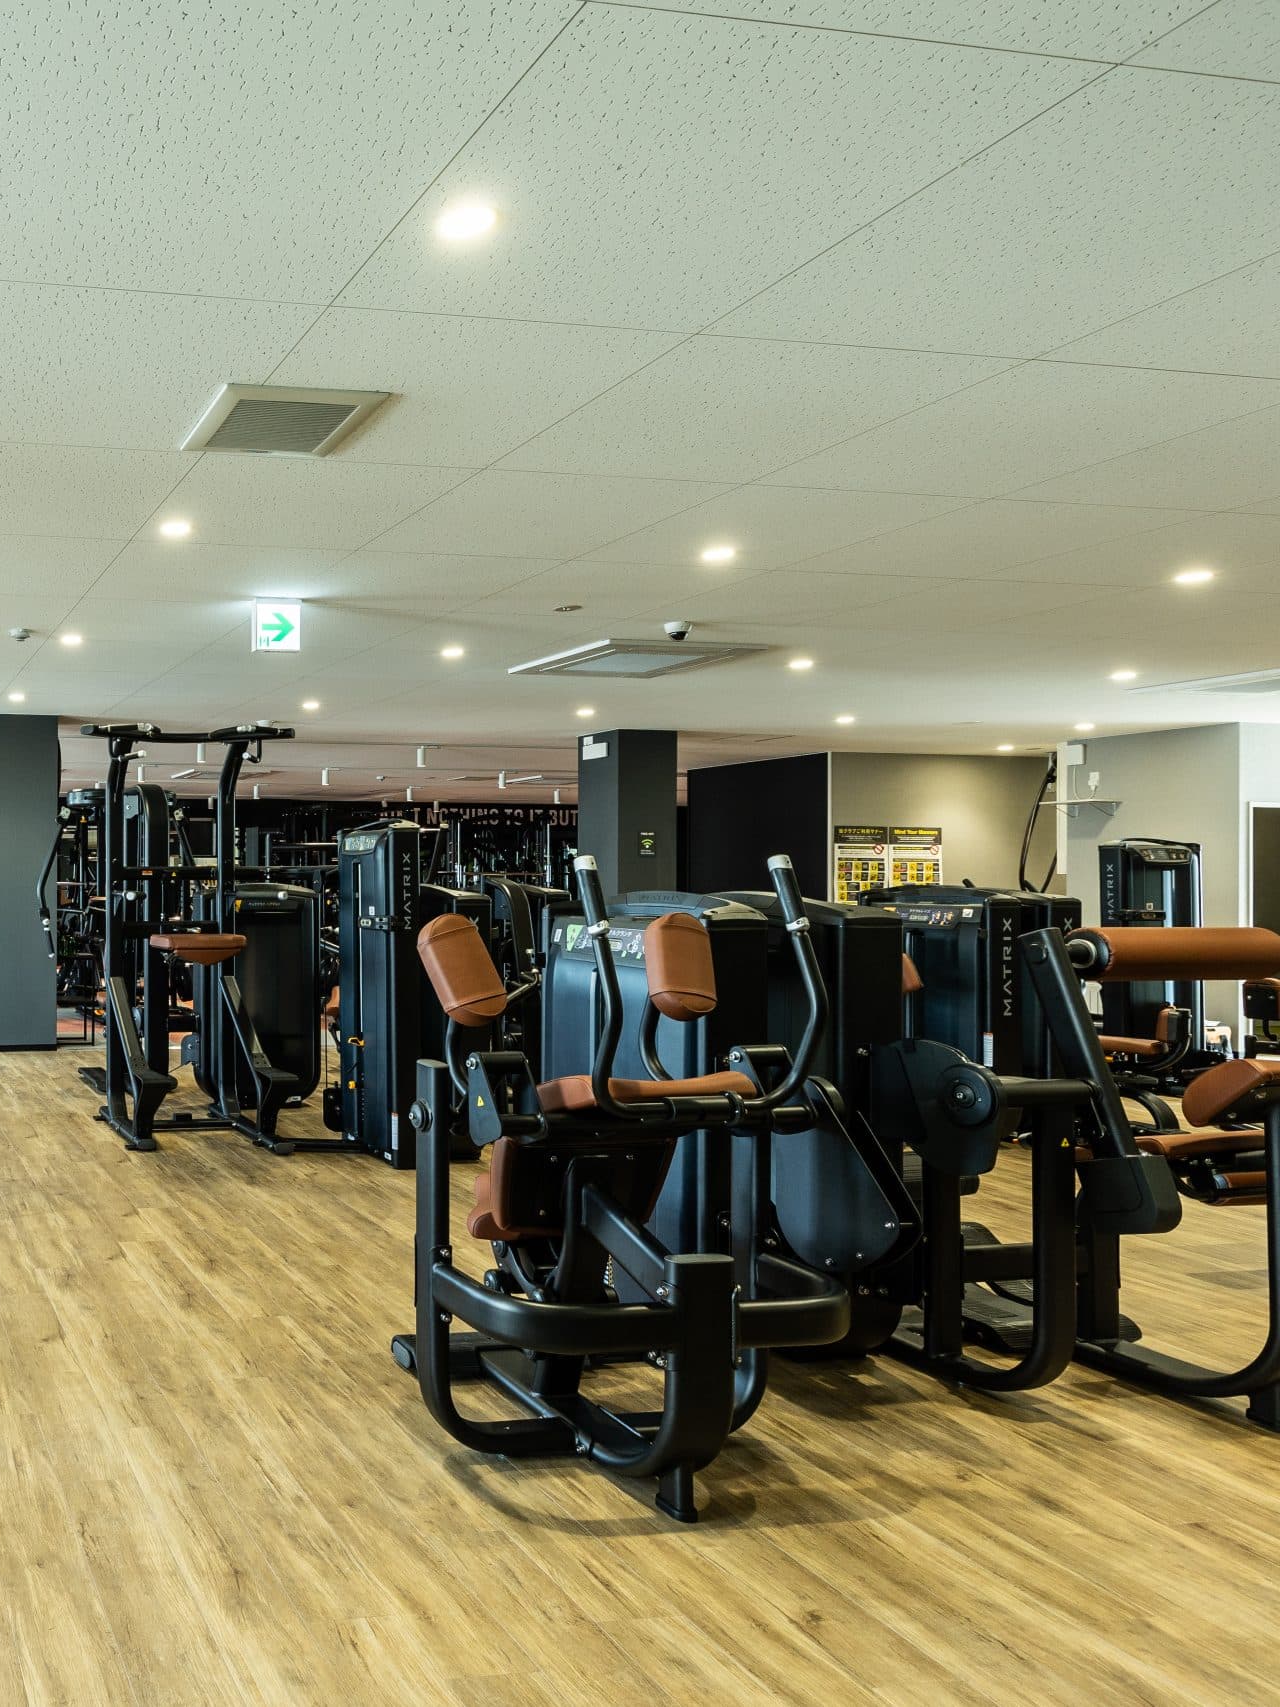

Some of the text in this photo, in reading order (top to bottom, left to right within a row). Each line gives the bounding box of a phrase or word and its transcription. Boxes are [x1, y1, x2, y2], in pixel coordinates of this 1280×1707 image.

[549, 809, 578, 827] BUT
[403, 852, 411, 930] MATRIX
[1106, 864, 1115, 920] MATRIX
[1002, 917, 1013, 1016] MATRIX
